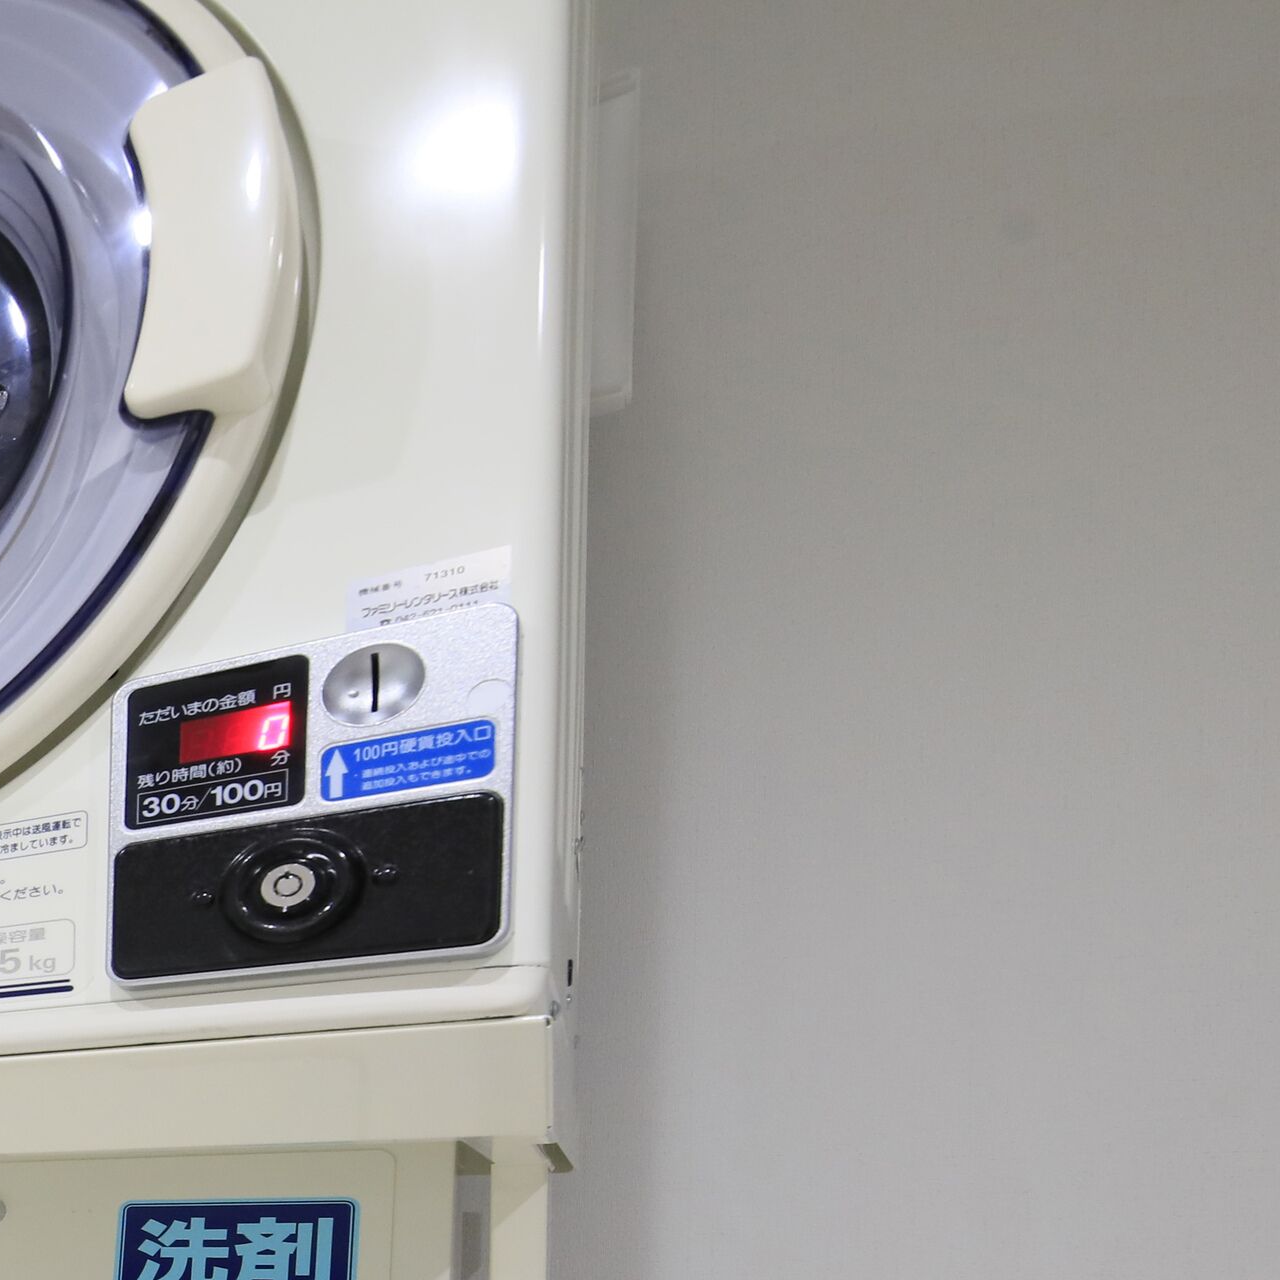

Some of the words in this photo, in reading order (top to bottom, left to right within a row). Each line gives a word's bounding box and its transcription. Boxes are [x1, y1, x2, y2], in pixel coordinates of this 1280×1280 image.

[424, 565, 465, 581] 71310
[138, 689, 256, 726] ただいまの金額
[273, 682, 291, 700] 円
[258, 714, 290, 751] 0
[354, 725, 491, 763] 100円硬貨投入口
[137, 758, 242, 789] 残り時間(約)
[271, 750, 290, 766] 分
[142, 779, 282, 818] 30分/100円
[29, 953, 57, 973] kg
